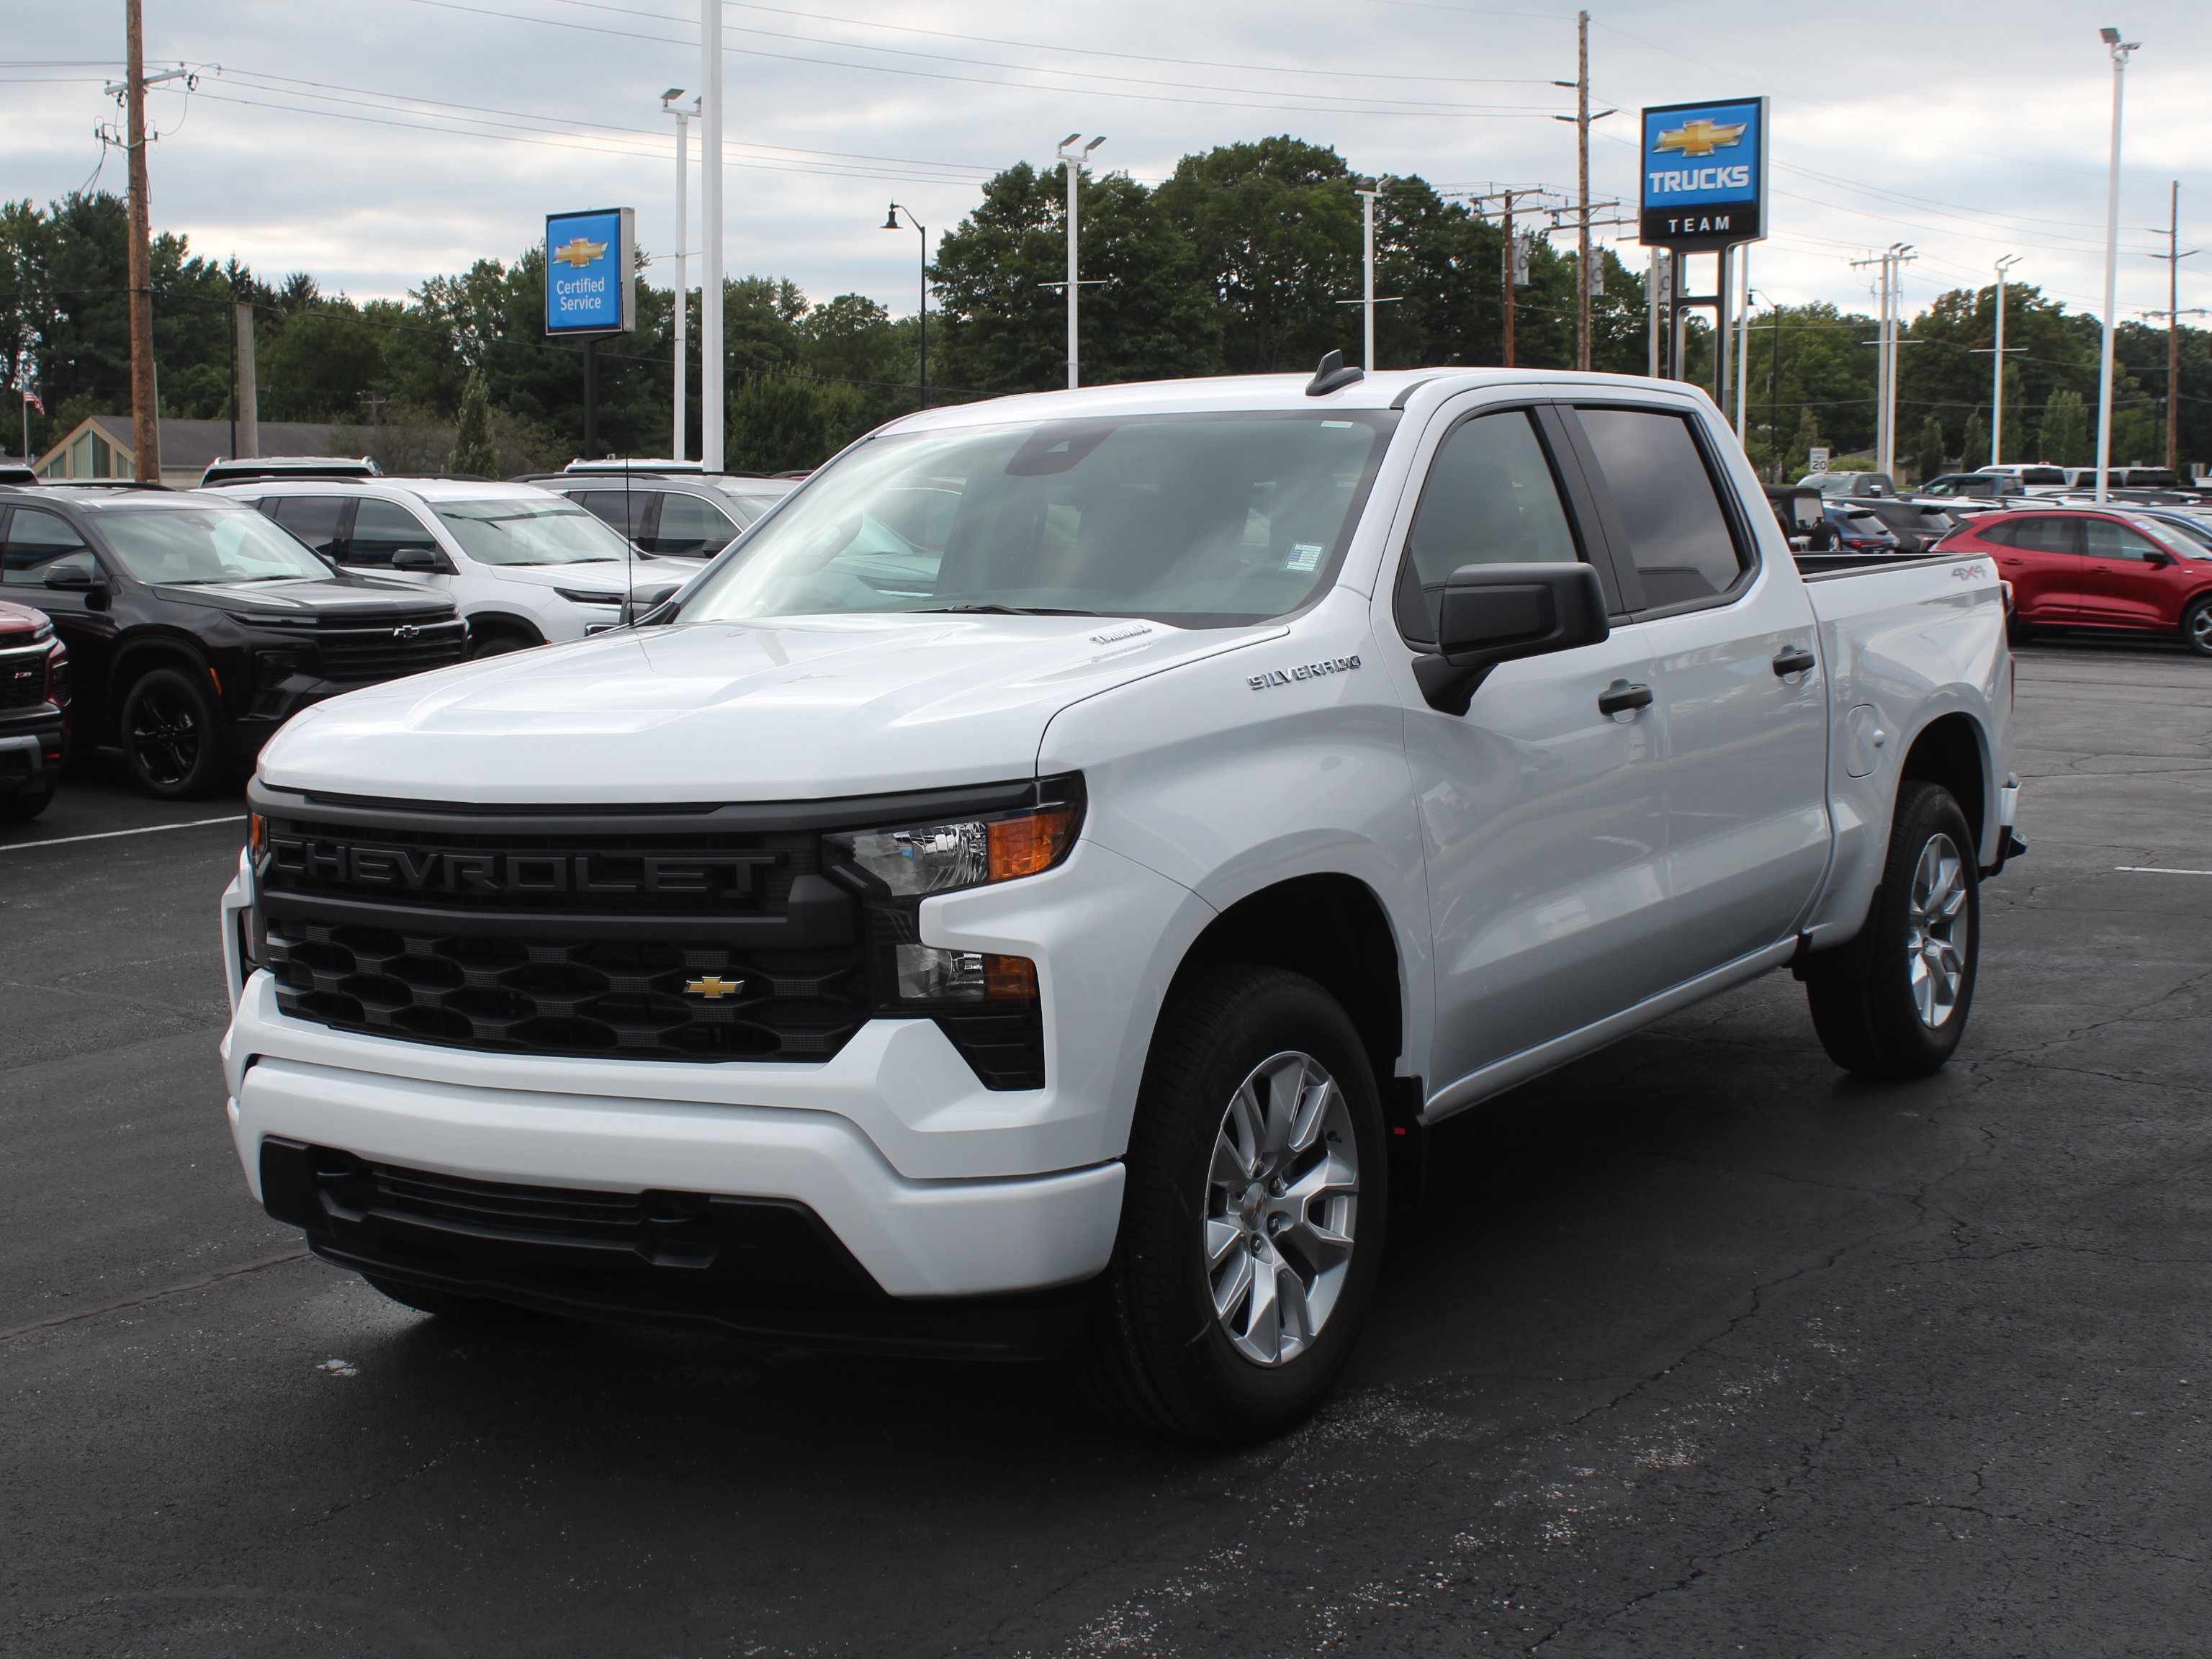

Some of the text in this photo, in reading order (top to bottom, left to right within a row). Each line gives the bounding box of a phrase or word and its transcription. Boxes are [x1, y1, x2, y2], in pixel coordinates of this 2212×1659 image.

[1649, 165, 1750, 193] TRUCKS
[1668, 216, 1730, 233] TEAM
[556, 276, 605, 295] Certified
[559, 295, 602, 311] Service
[1812, 460, 1827, 469] 20
[1246, 654, 1362, 691] SILVERADO
[269, 837, 783, 894] CHEVROLET
